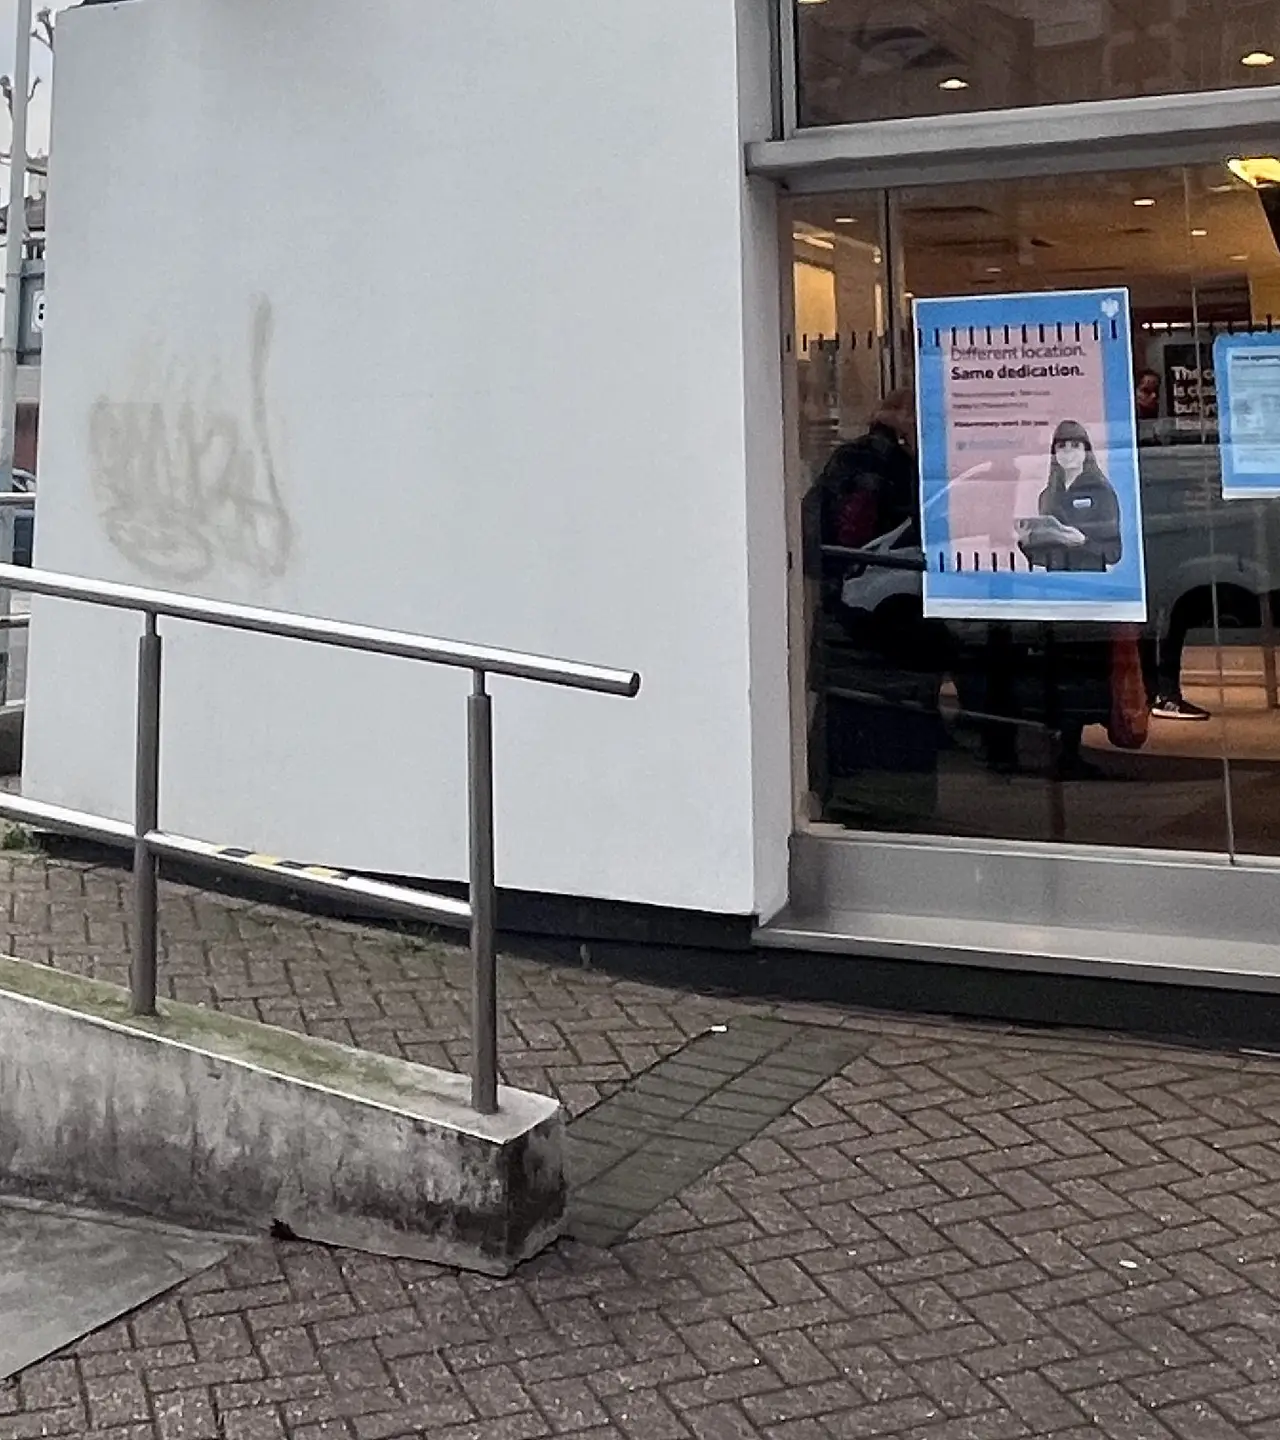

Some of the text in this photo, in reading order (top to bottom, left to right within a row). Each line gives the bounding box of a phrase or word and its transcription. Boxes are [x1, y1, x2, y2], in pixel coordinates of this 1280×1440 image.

[951, 345, 1087, 361] Different location.
[951, 363, 1085, 381] Same dedication.
